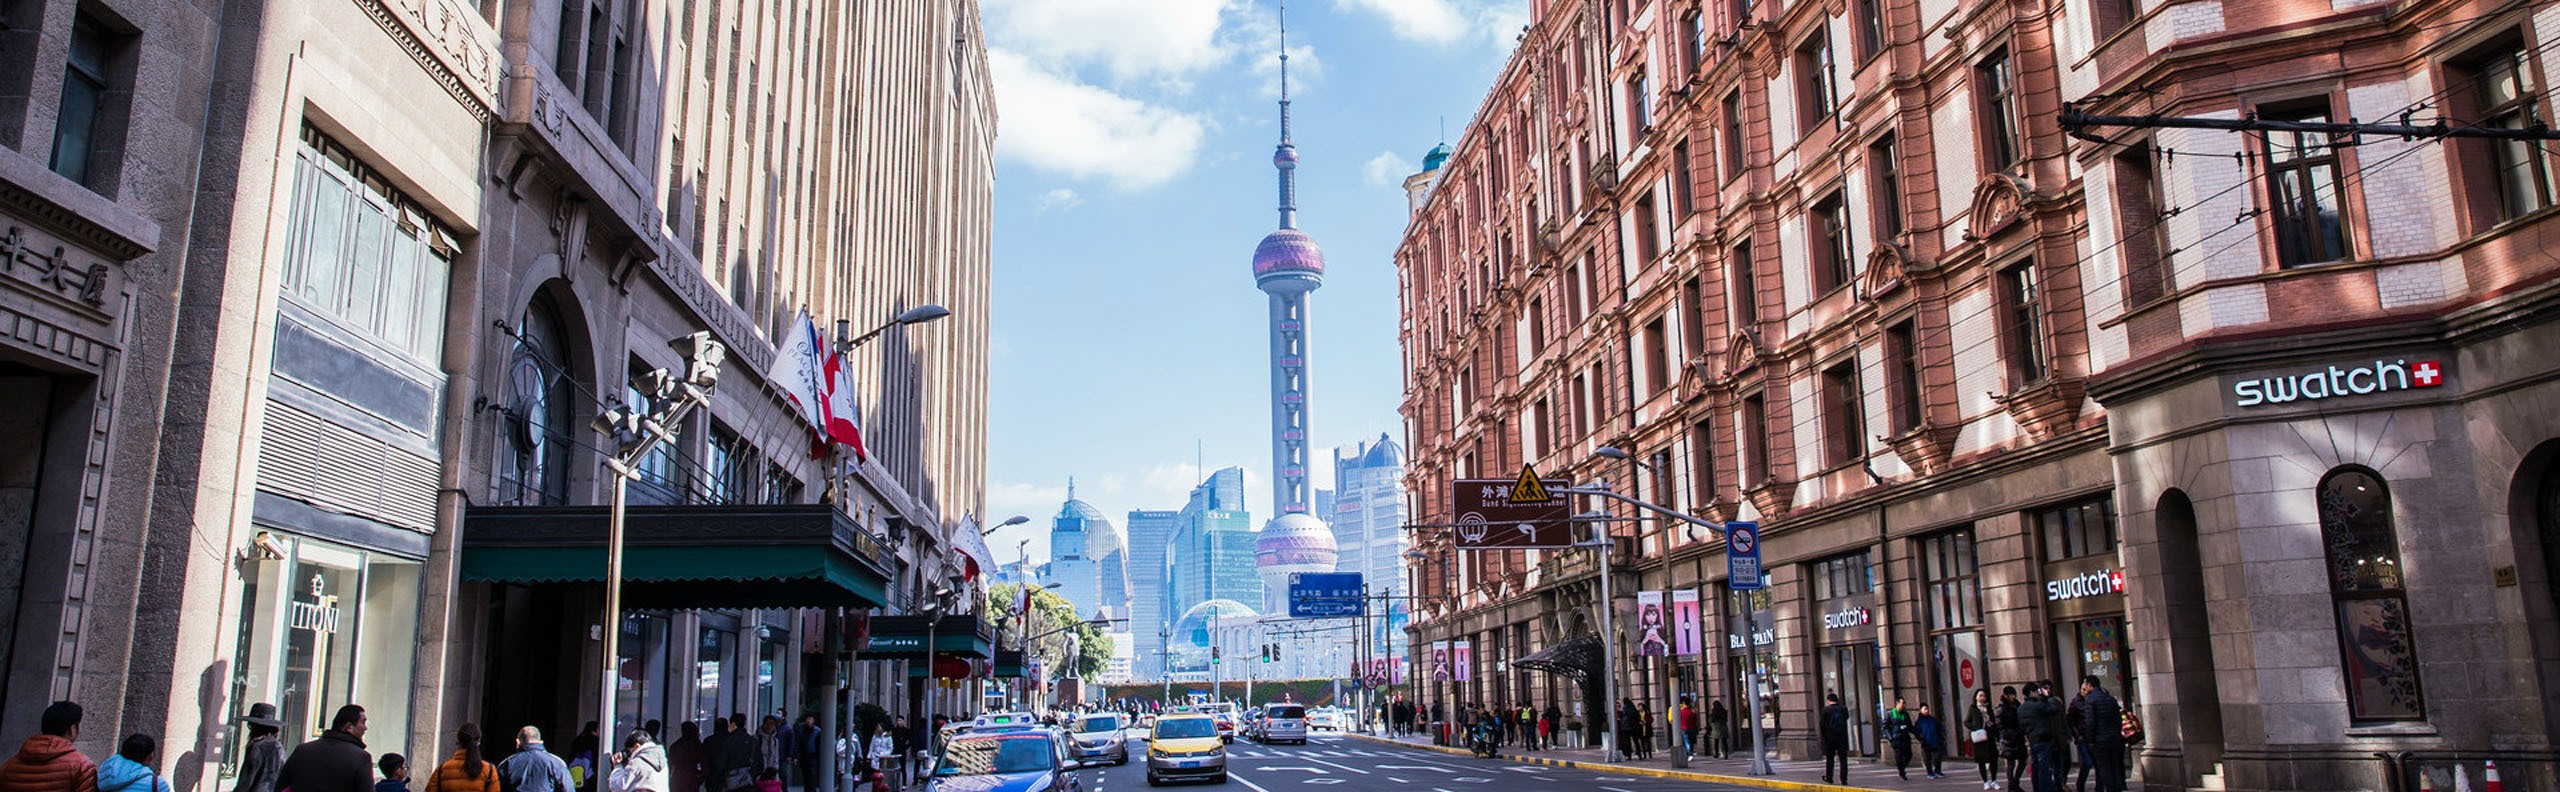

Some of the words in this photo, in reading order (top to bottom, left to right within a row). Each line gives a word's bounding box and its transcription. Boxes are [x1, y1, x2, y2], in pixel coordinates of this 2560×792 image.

[2234, 360, 2408, 407] swatch
[1482, 485, 1565, 498] 外滩道
[2047, 569, 2112, 601] swatch
[290, 601, 340, 634] TITONI
[1824, 606, 1862, 629] swatch
[1729, 628, 1774, 649] BLAPAIN
